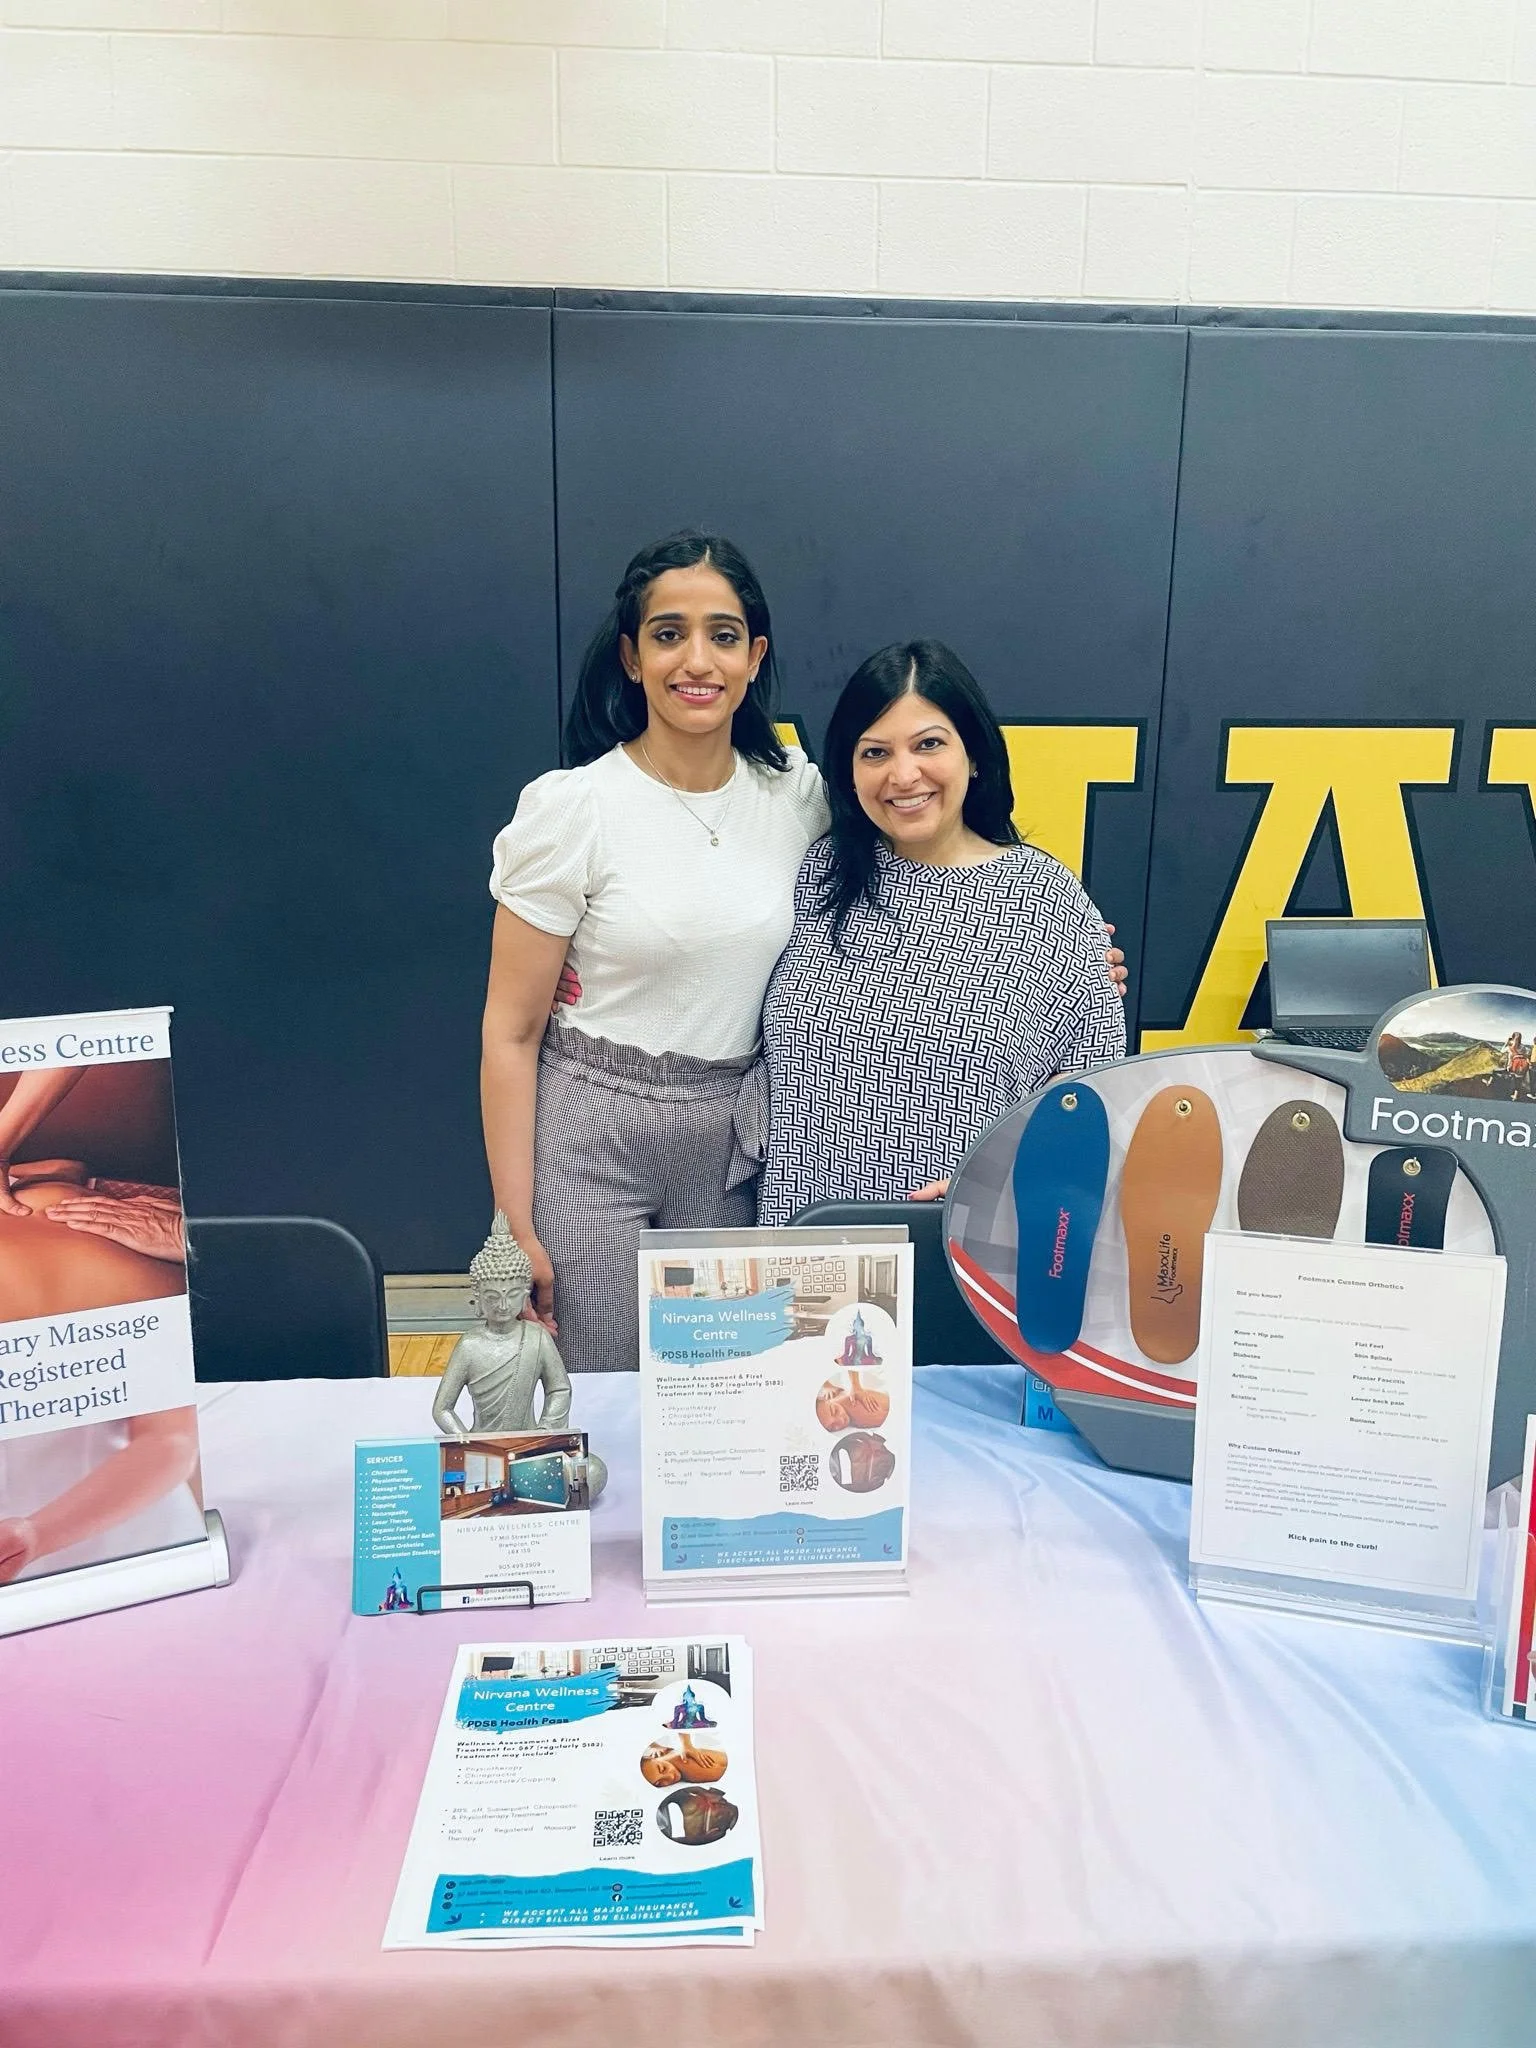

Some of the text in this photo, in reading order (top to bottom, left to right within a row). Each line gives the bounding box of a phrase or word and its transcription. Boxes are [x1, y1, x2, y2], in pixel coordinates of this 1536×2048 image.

[56, 1034, 154, 1059] Centre
[1371, 1097, 1536, 1148] Footma
[1396, 1192, 1416, 1246] otmaxx
[1048, 1210, 1070, 1278] Footmaxx
[1157, 1234, 1171, 1287] MaxxLife
[1368, 1281, 1404, 1290] Orthotics
[662, 1309, 777, 1324] Nirvana Wellness
[48, 1314, 160, 1347] Massage
[693, 1329, 738, 1340] Centre
[662, 1349, 752, 1359] PDSB Health Pass
[0, 1381, 128, 1424] Therapist!
[366, 1455, 404, 1464] SERVICES
[457, 1519, 580, 1534] NIRVANA WELLNESS CENTRE
[1288, 1533, 1307, 1541] Kick
[474, 1687, 600, 1700] Nirvana Wellness
[505, 1702, 555, 1712] Centre
[500, 1718, 538, 1727] Health
[593, 1905, 629, 1914] MAJOR
[634, 1901, 695, 1911] INSURANCE
[593, 1914, 608, 1922] ON
[613, 1912, 661, 1921] ELIGIBLE
[666, 1909, 699, 1918] PLANS
